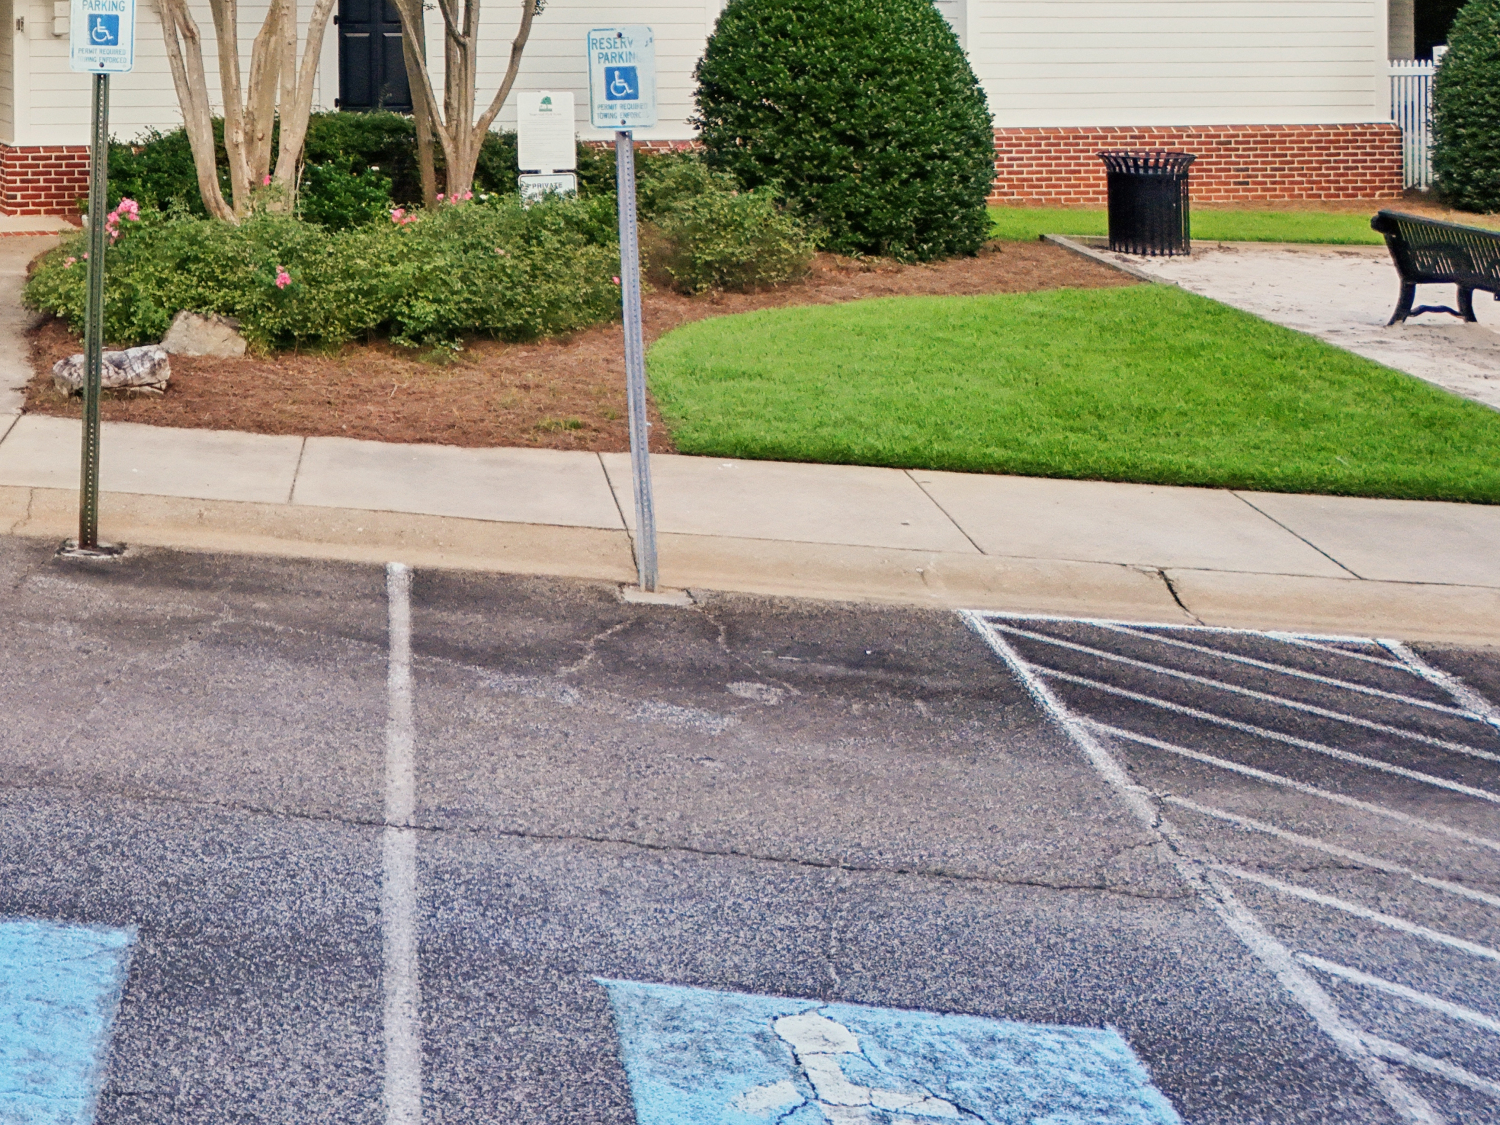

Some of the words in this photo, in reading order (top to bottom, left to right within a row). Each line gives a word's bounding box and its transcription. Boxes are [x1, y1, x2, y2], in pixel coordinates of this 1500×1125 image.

[82, 0, 125, 12] PARKING
[591, 37, 638, 50] RESERV
[598, 51, 639, 64] PARKIN
